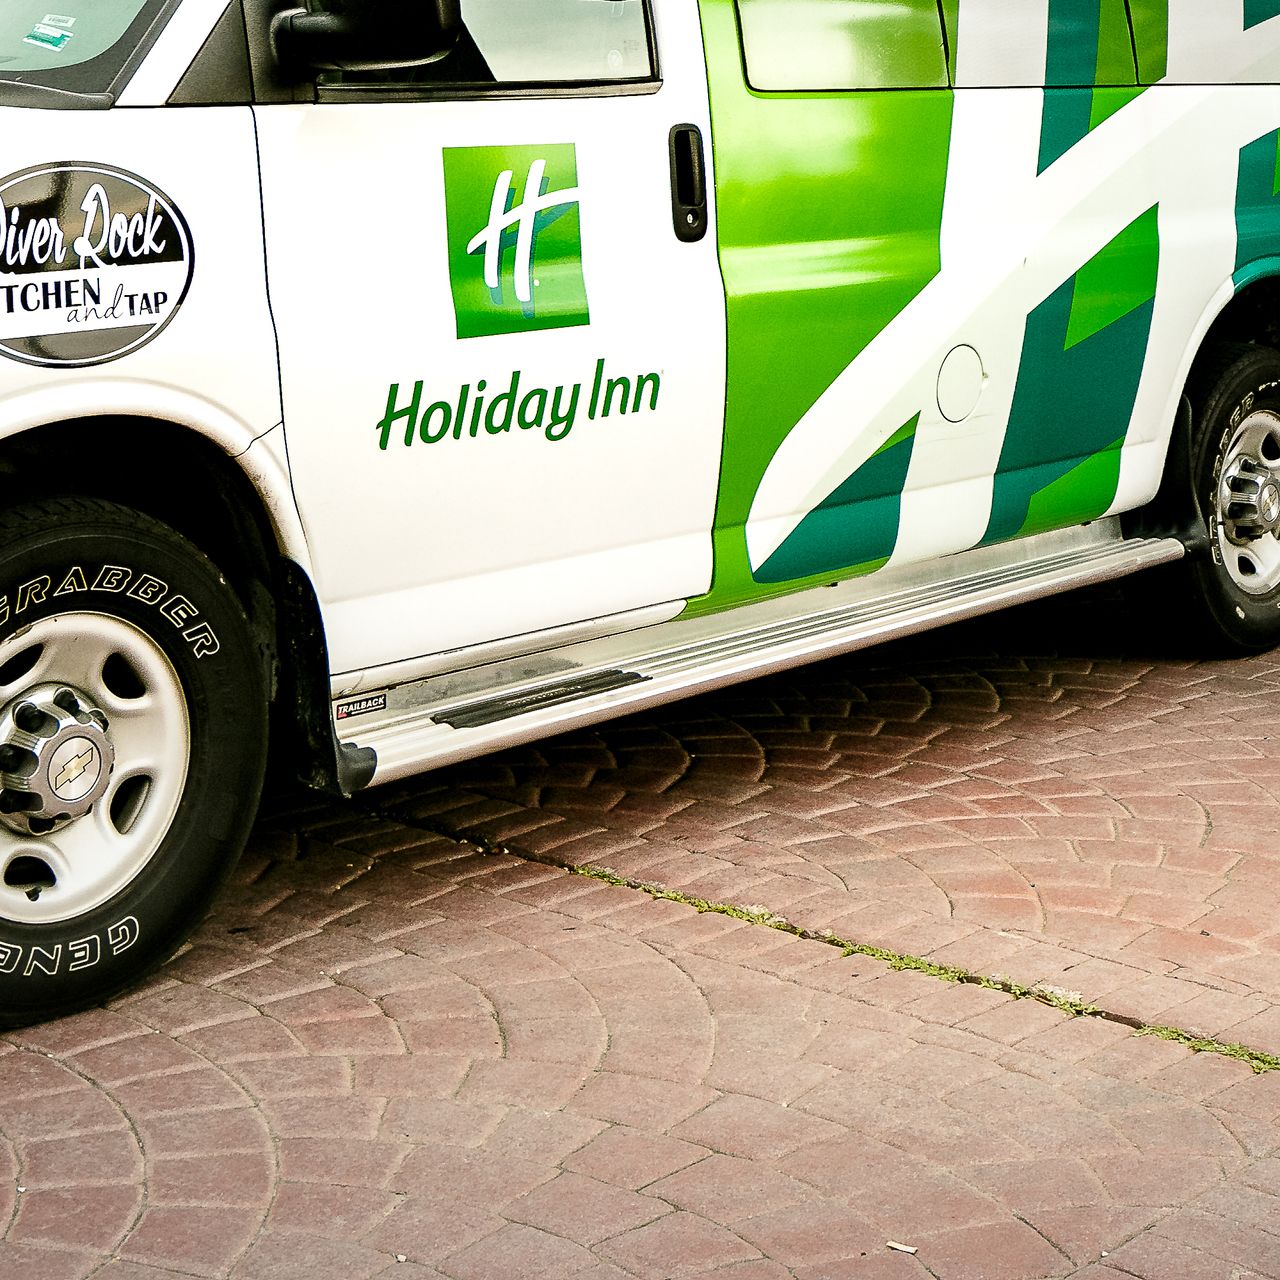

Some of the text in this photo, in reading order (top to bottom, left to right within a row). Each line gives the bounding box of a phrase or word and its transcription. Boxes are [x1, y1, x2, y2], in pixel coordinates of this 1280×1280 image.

[73, 183, 166, 270] Rock
[67, 283, 124, 323] and
[124, 291, 168, 317] TAP
[376, 358, 661, 450] Holiday Inn
[338, 695, 385, 714] TRAILBACK
